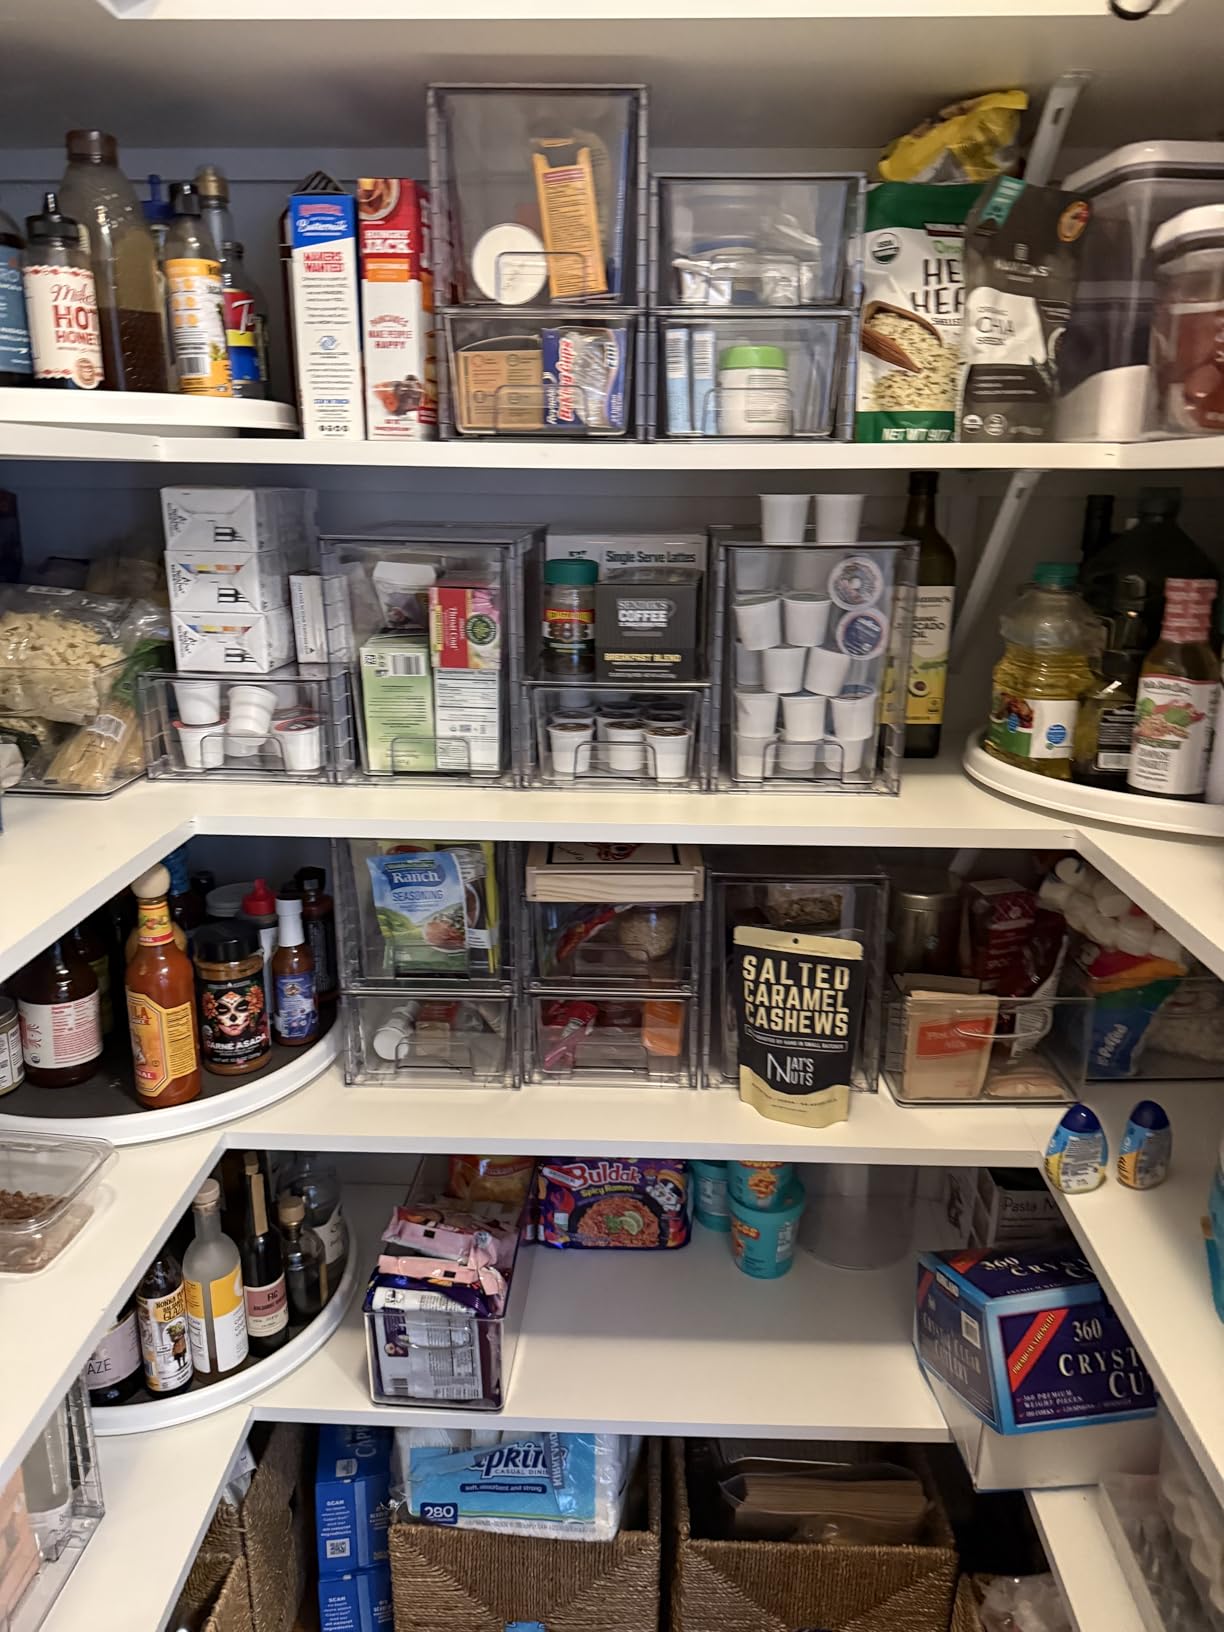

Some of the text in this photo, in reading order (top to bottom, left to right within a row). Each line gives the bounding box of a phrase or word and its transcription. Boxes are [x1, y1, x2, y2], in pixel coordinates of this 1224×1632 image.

[555, 338, 573, 374] Cups
[606, 550, 696, 565] Single Serve Lattes
[618, 610, 668, 622] COFFEE
[653, 654, 682, 662] BLEND
[392, 871, 441, 884] Ranch
[392, 890, 443, 901] SEASONING
[743, 954, 849, 990] SALTED
[744, 981, 849, 1013] CARAMEL
[745, 1004, 848, 1037] CASHEWS
[235, 1033, 267, 1049] ASADA
[559, 1162, 641, 1191] Buldak
[581, 1185, 635, 1197] Spicy Ramen
[267, 1290, 278, 1302] FIG
[1073, 1318, 1103, 1342] 360
[1109, 1371, 1145, 1398] CU
[1037, 1390, 1073, 1399] PREMIUM
[424, 1505, 454, 1519] 280
